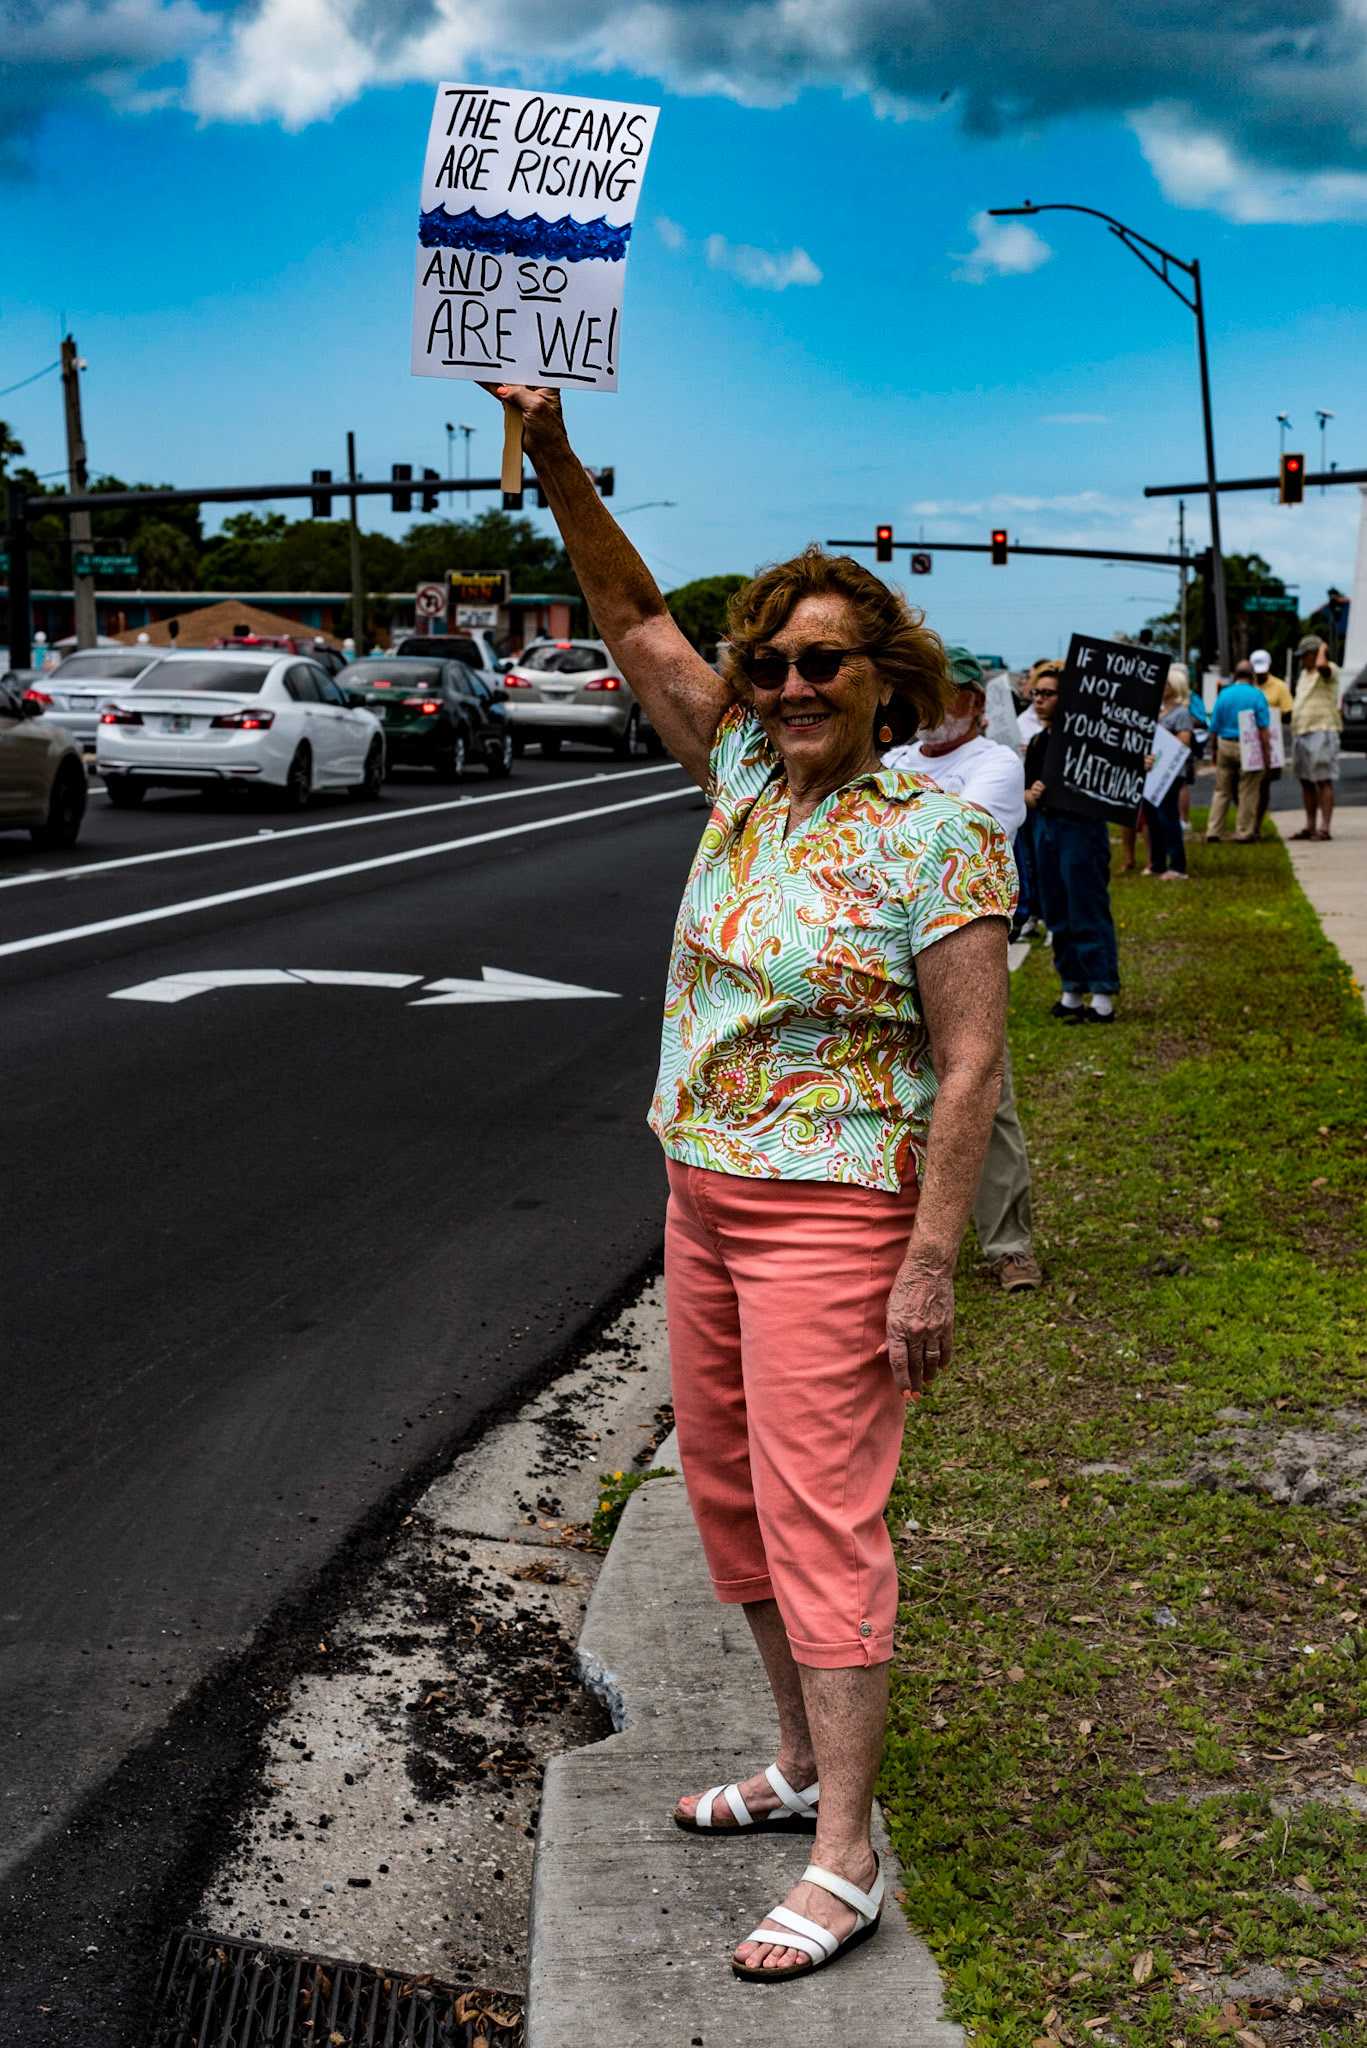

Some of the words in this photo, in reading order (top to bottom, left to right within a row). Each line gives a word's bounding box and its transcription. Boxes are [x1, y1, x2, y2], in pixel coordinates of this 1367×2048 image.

[445, 89, 510, 141] THE
[514, 96, 647, 157] OCEANS
[435, 144, 499, 191] ARE
[507, 149, 636, 202] RISING
[422, 250, 503, 292] AND
[516, 261, 568, 294] SO
[426, 298, 517, 363] ARE
[536, 307, 618, 376] WE!
[1076, 646, 1098, 669] IF
[1106, 652, 1160, 685] YOU'RE
[1079, 674, 1122, 701] NOT
[1120, 728, 1153, 757] NOT
[1063, 741, 1144, 804] WATCHING
